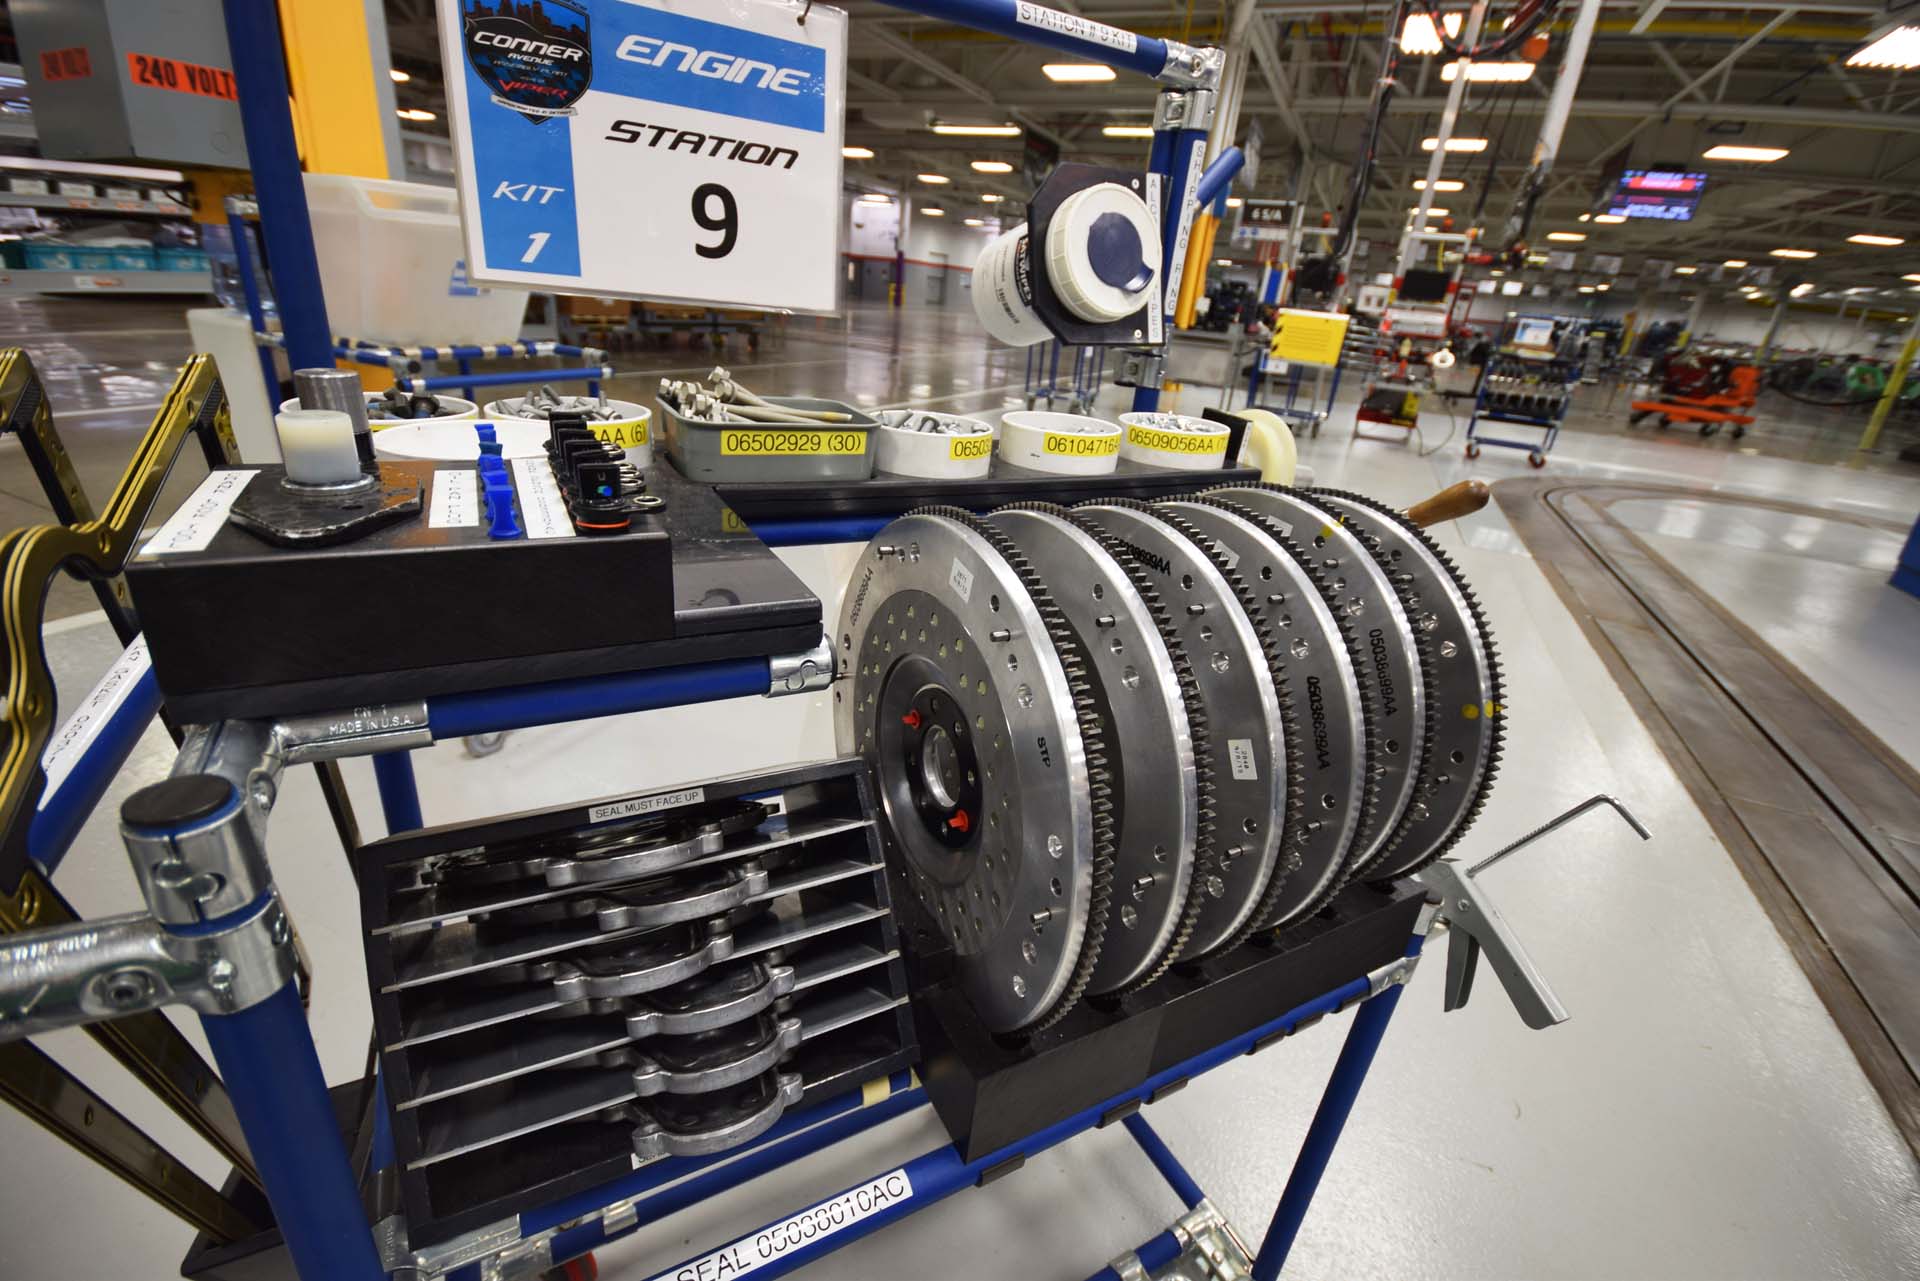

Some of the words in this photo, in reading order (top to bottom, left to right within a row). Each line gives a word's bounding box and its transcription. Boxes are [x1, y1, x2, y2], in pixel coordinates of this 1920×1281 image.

[1021, 4, 1085, 35] STATION
[1111, 30, 1133, 49] KIT
[473, 31, 584, 62] CONNER
[507, 52, 555, 66] AVENUE
[135, 54, 177, 89] 240
[183, 64, 237, 99] VOLT
[616, 34, 811, 95] ENGINE
[604, 119, 799, 170] STATION
[492, 180, 566, 205] KIT
[1179, 145, 1204, 249] SHIPPING
[691, 182, 738, 259] 9
[520, 231, 552, 264] 1
[1167, 263, 1182, 310] RING
[630, 424, 647, 444] (6)
[726, 433, 822, 452] 06502929
[827, 434, 861, 451] (30)
[1129, 428, 1214, 452] 06509056AA
[329, 719, 362, 736] MADE
[367, 719, 378, 730] IN
[381, 714, 415, 729] U.S.A.
[595, 807, 623, 819] SEAL
[625, 800, 654, 814] MUST
[656, 794, 683, 807] FACE
[684, 791, 699, 802] UP
[756, 1175, 905, 1259] 05038010AC
